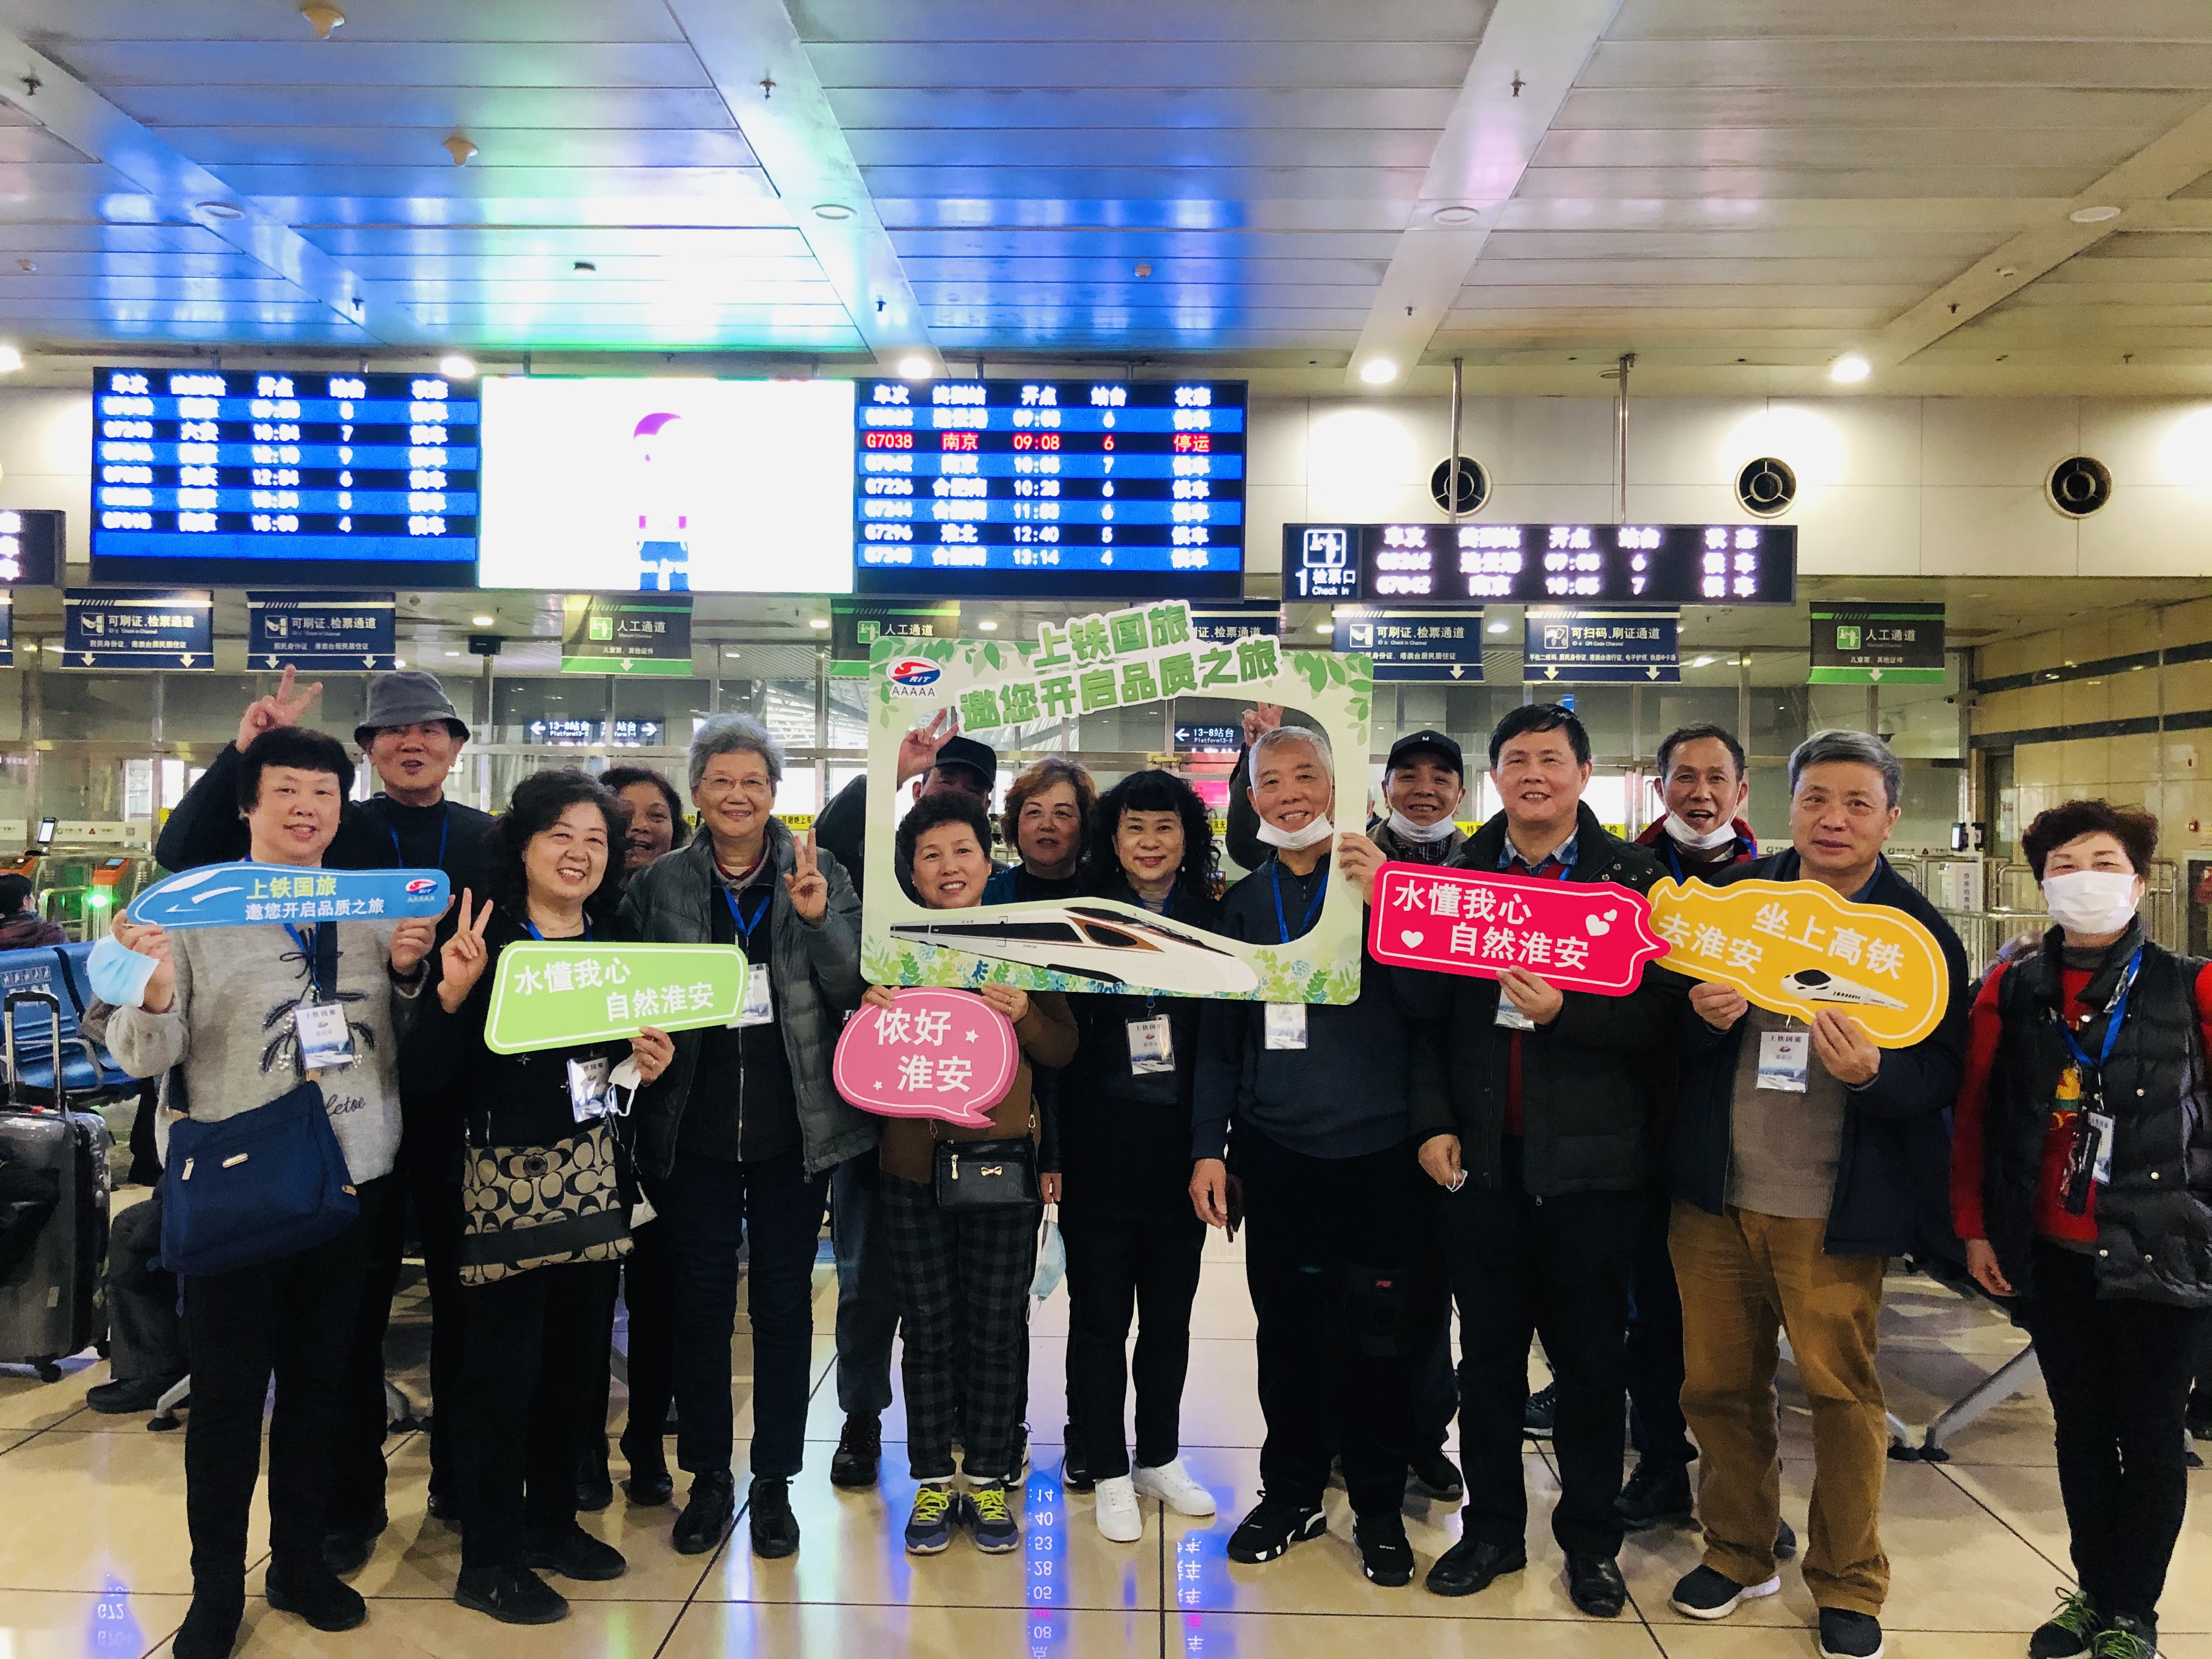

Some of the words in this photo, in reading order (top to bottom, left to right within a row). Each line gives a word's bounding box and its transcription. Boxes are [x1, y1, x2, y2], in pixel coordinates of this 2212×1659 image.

[867, 433, 913, 448] G7038
[943, 432, 978, 450] 南京
[1013, 436, 1060, 450] 09:08
[1104, 436, 1114, 450] 6
[1173, 435, 1210, 452] 停运
[1104, 458, 1114, 473] 7
[1103, 481, 1113, 496] 6
[1102, 504, 1113, 520] 6
[1014, 527, 1059, 542] 12:40
[1102, 527, 1112, 543] 5
[1014, 549, 1059, 565] 13:14
[1102, 550, 1112, 565] 4
[1295, 568, 1307, 596] 1
[1312, 568, 1355, 585] 检票口
[1312, 586, 1338, 595] Check
[1341, 586, 1349, 595] in
[1632, 578, 1645, 594] 7
[617, 620, 666, 633] 人工通道
[885, 623, 934, 636] 人工通道
[1193, 626, 1261, 638] 证、检票通道
[1865, 629, 1916, 641] 人工通道
[1034, 605, 1190, 669] 上铁国旅
[892, 686, 935, 697] AAAAA
[960, 639, 1278, 731] 邀您开启品质之旅
[549, 721, 590, 731] 13-8站台
[1193, 728, 1234, 737] 13-8站台
[246, 876, 336, 900] 上铁国旅
[246, 898, 383, 921] 邀您开启品质之旅
[1393, 880, 1532, 924] 水懂我心
[1450, 922, 1589, 970] 自然淮安
[1658, 913, 1763, 974] 去淮安
[1752, 902, 1904, 980] 坐上高铁
[514, 957, 631, 996] 水懂我心
[606, 981, 714, 1022] 自然淮安
[874, 1008, 951, 1046] 侬好
[898, 1054, 972, 1092] 淮安
